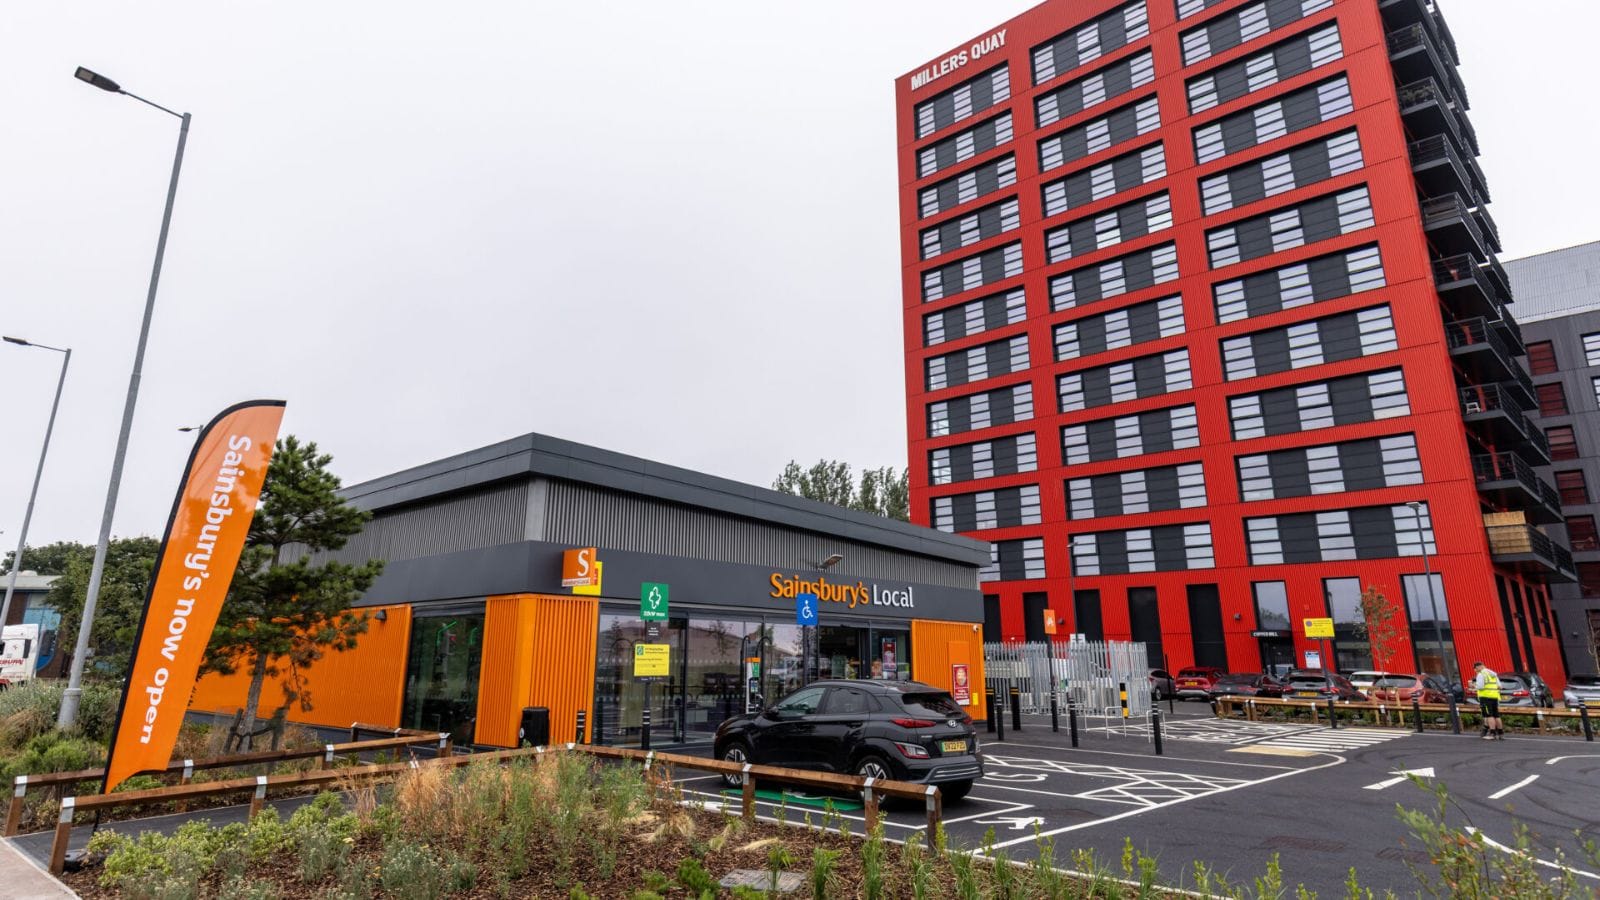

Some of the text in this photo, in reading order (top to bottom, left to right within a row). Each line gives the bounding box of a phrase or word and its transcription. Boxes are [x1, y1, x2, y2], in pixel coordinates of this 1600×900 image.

[911, 29, 1007, 91] MILLERS QUAY
[577, 550, 589, 577] S
[140, 434, 251, 745] Sainsbury's now open
[769, 572, 914, 609] Sainsbury's Local
